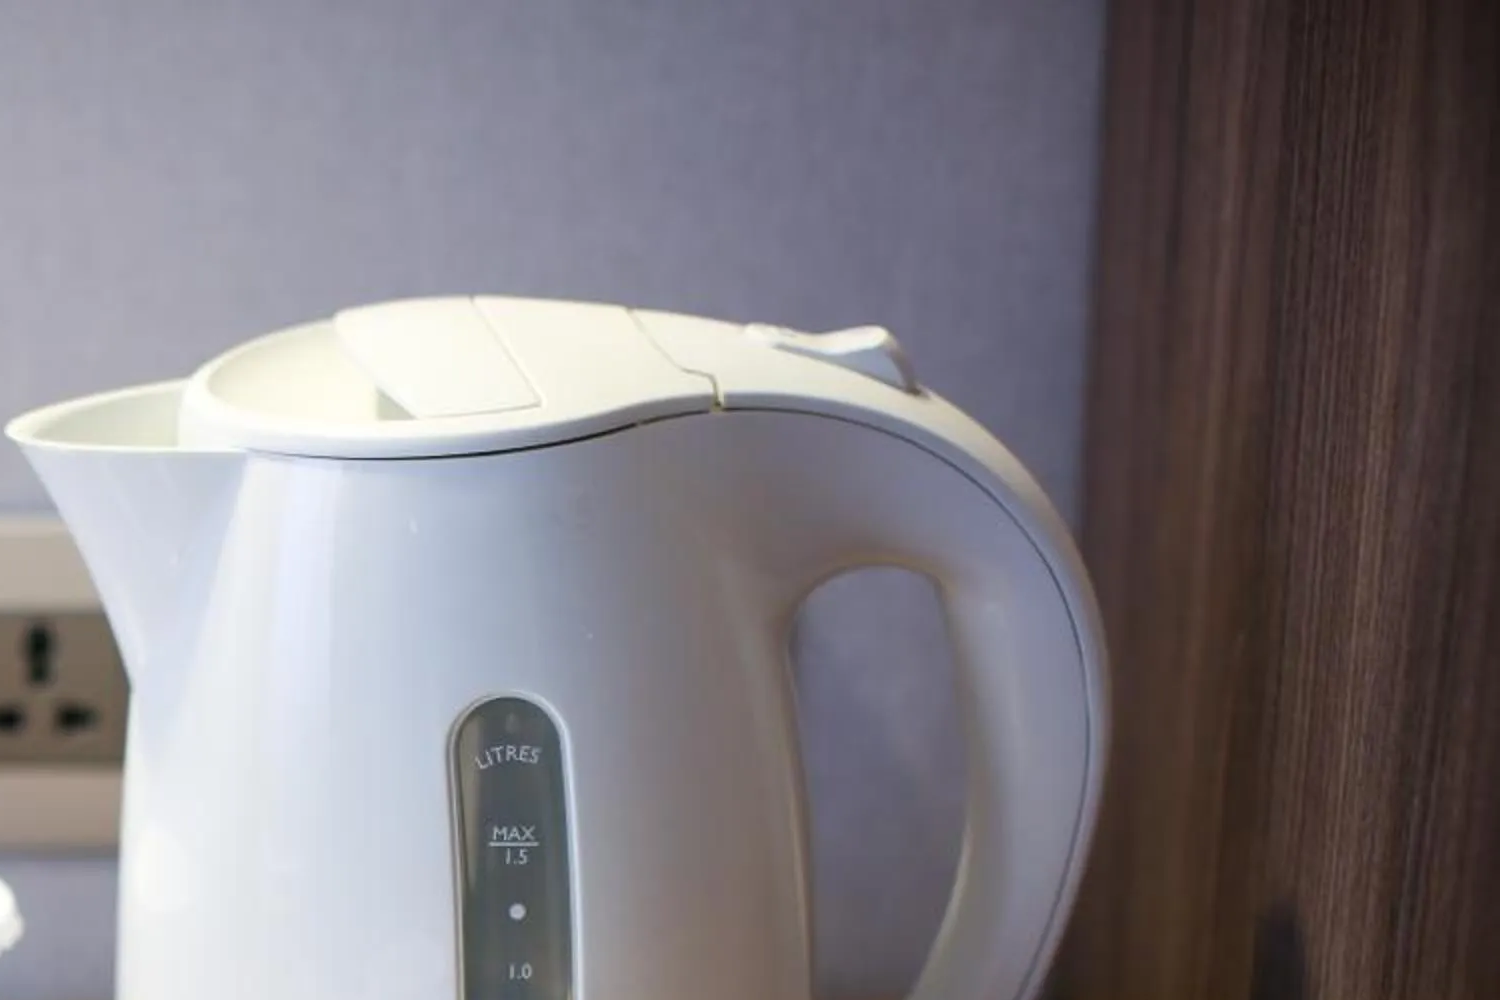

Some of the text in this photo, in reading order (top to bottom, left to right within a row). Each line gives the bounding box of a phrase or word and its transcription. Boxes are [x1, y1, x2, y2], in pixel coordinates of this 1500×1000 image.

[475, 745, 541, 769] LITRES
[492, 825, 536, 841] MAX
[505, 848, 529, 865] 1.5
[508, 963, 533, 980] 1.0
